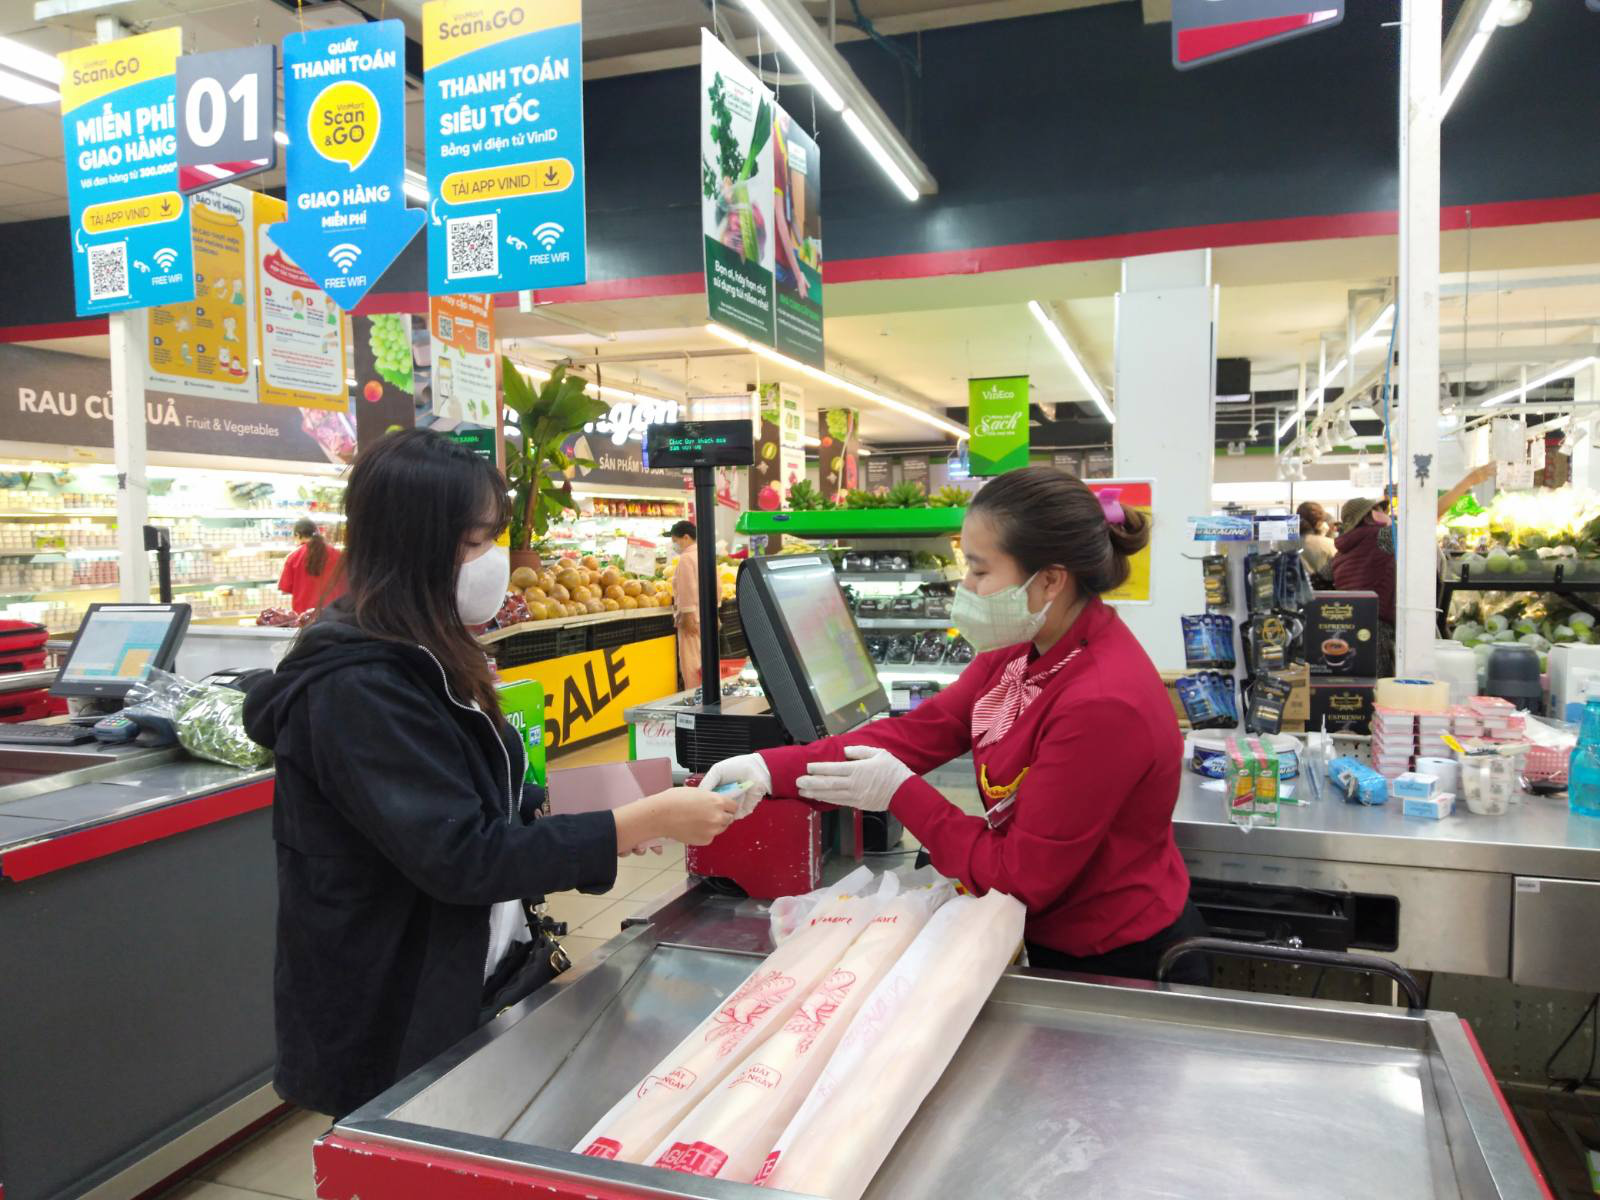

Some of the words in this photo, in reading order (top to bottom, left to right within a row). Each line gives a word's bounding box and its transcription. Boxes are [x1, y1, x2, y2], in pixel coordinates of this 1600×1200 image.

[438, 7, 525, 40] Scan&GO
[73, 57, 140, 86] Scan&GO
[291, 57, 347, 80] THANH
[349, 48, 396, 72] TOÁN
[438, 69, 506, 100] THANH
[509, 56, 569, 87] TOÁN
[76, 102, 132, 146] MIỄN
[136, 94, 176, 134] PHÍ
[185, 73, 259, 147] 01
[323, 110, 365, 126] Scan
[440, 104, 487, 136] SIÊU
[490, 92, 540, 126] TỐC
[325, 124, 365, 146] &GO
[526, 128, 558, 144] VinID
[78, 145, 123, 171] GIAO
[125, 134, 176, 162] HÀNG
[297, 190, 340, 210] GIAO
[342, 183, 391, 206] HÀNG
[472, 179, 495, 193] APP
[498, 174, 531, 190] VINID
[106, 210, 123, 224] APP
[124, 206, 150, 221] VINID
[529, 255, 550, 265] FREE
[151, 275, 169, 286] FREE
[324, 278, 346, 289] FREE
[18, 387, 77, 417] RAU
[145, 398, 181, 427] UẢ
[185, 415, 211, 430] Fruit
[213, 418, 221, 431] &
[223, 419, 280, 437] Vegetables
[544, 646, 630, 748] SALE
